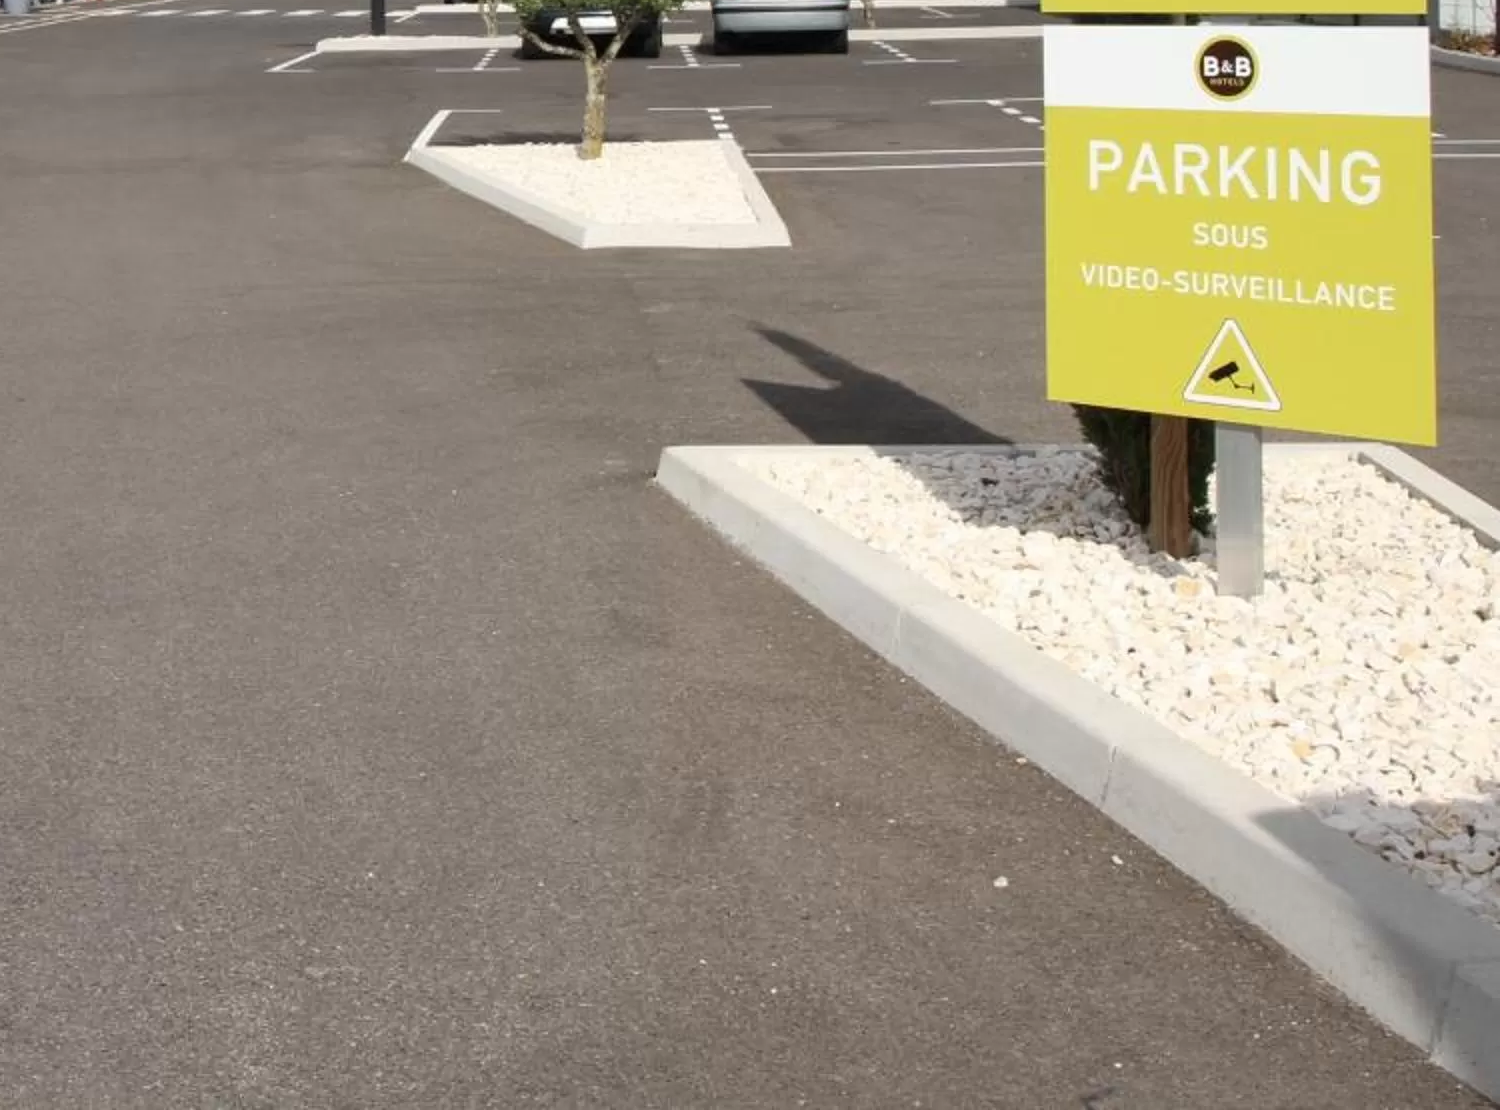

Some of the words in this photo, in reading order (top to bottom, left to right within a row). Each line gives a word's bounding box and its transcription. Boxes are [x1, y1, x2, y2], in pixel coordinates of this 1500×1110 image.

[1203, 55, 1252, 77] B&B
[1086, 138, 1384, 206] PARKING
[1193, 221, 1268, 250] SOUS
[1080, 262, 1396, 311] VIDEO-SURVEILLANCE
